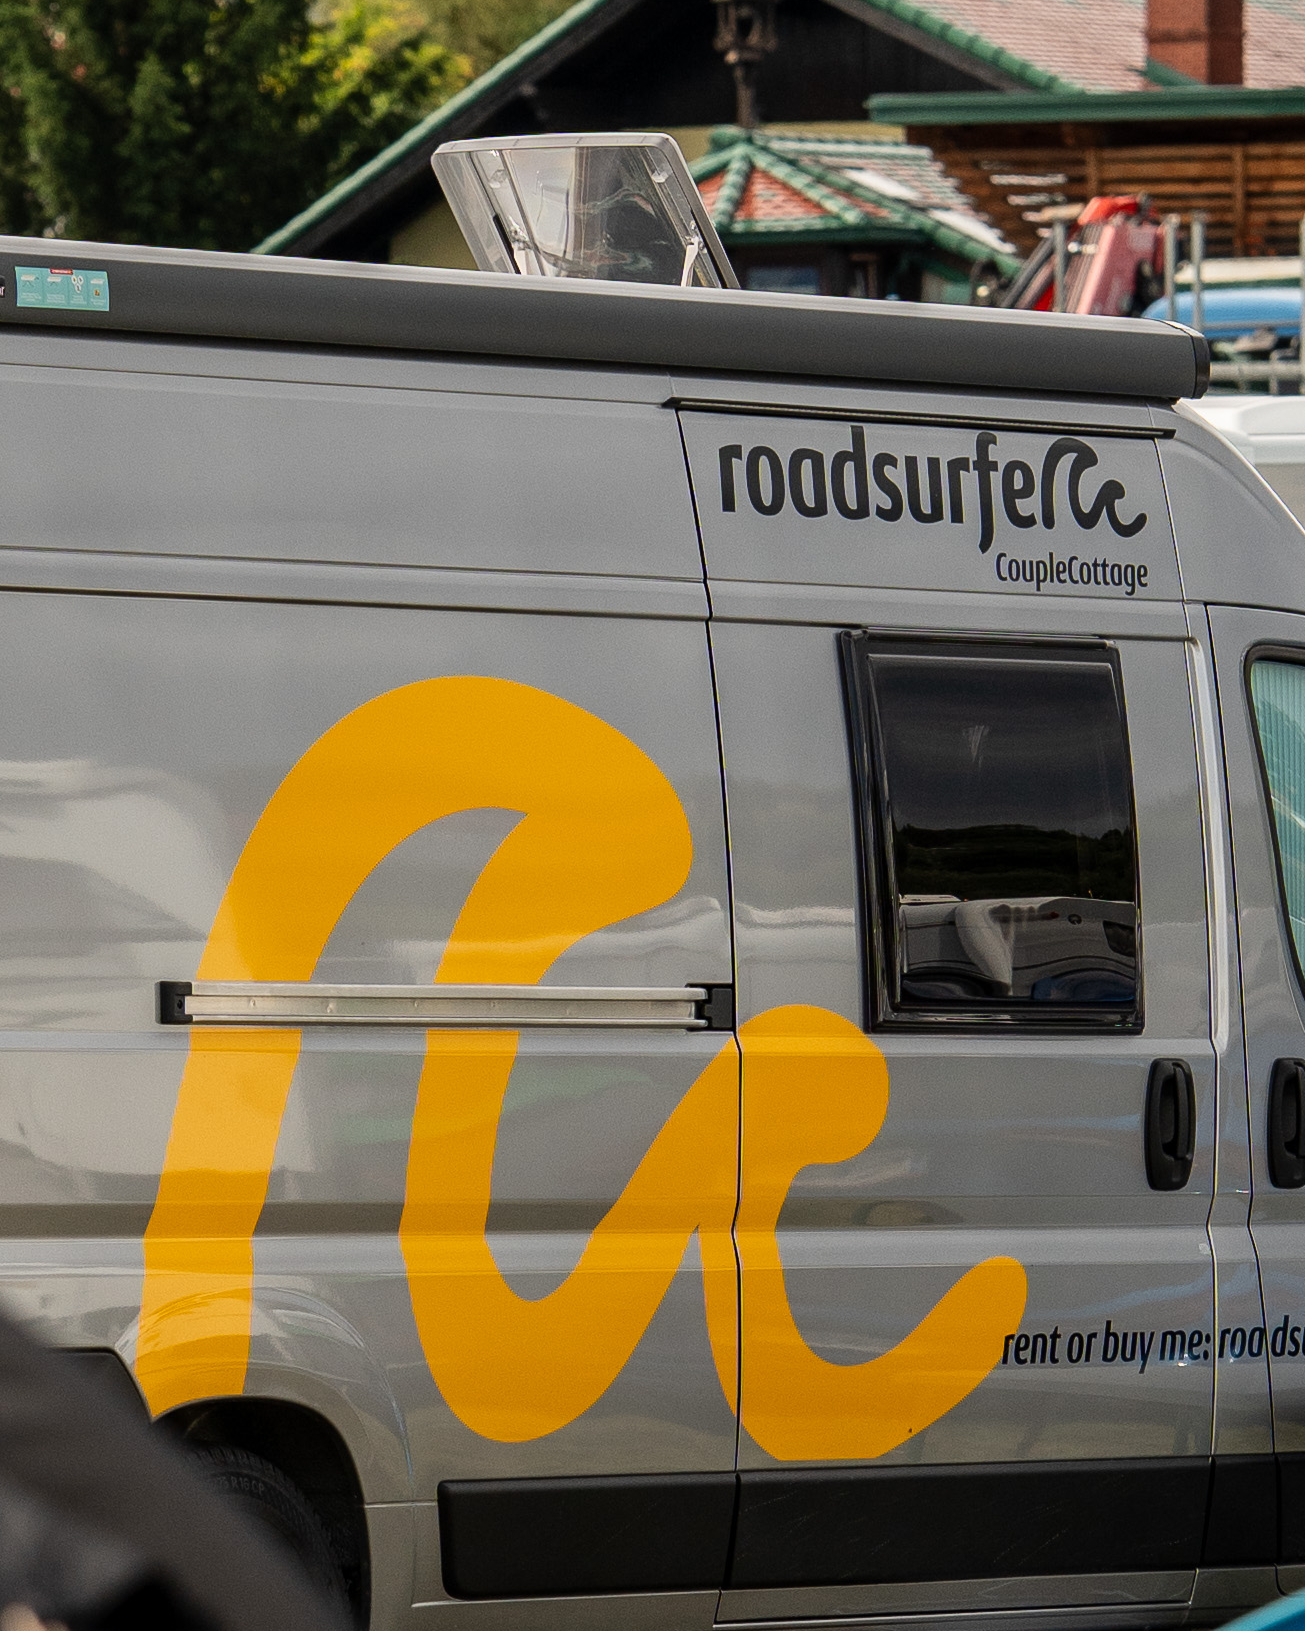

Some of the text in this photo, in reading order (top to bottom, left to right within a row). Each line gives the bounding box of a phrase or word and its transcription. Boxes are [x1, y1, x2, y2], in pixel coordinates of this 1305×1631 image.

[995, 552, 1149, 596] CoupleCottage
[1002, 1326, 1062, 1365] rent
[1067, 1332, 1098, 1364] or
[1102, 1320, 1155, 1374] buy
[1159, 1329, 1211, 1361] me:
